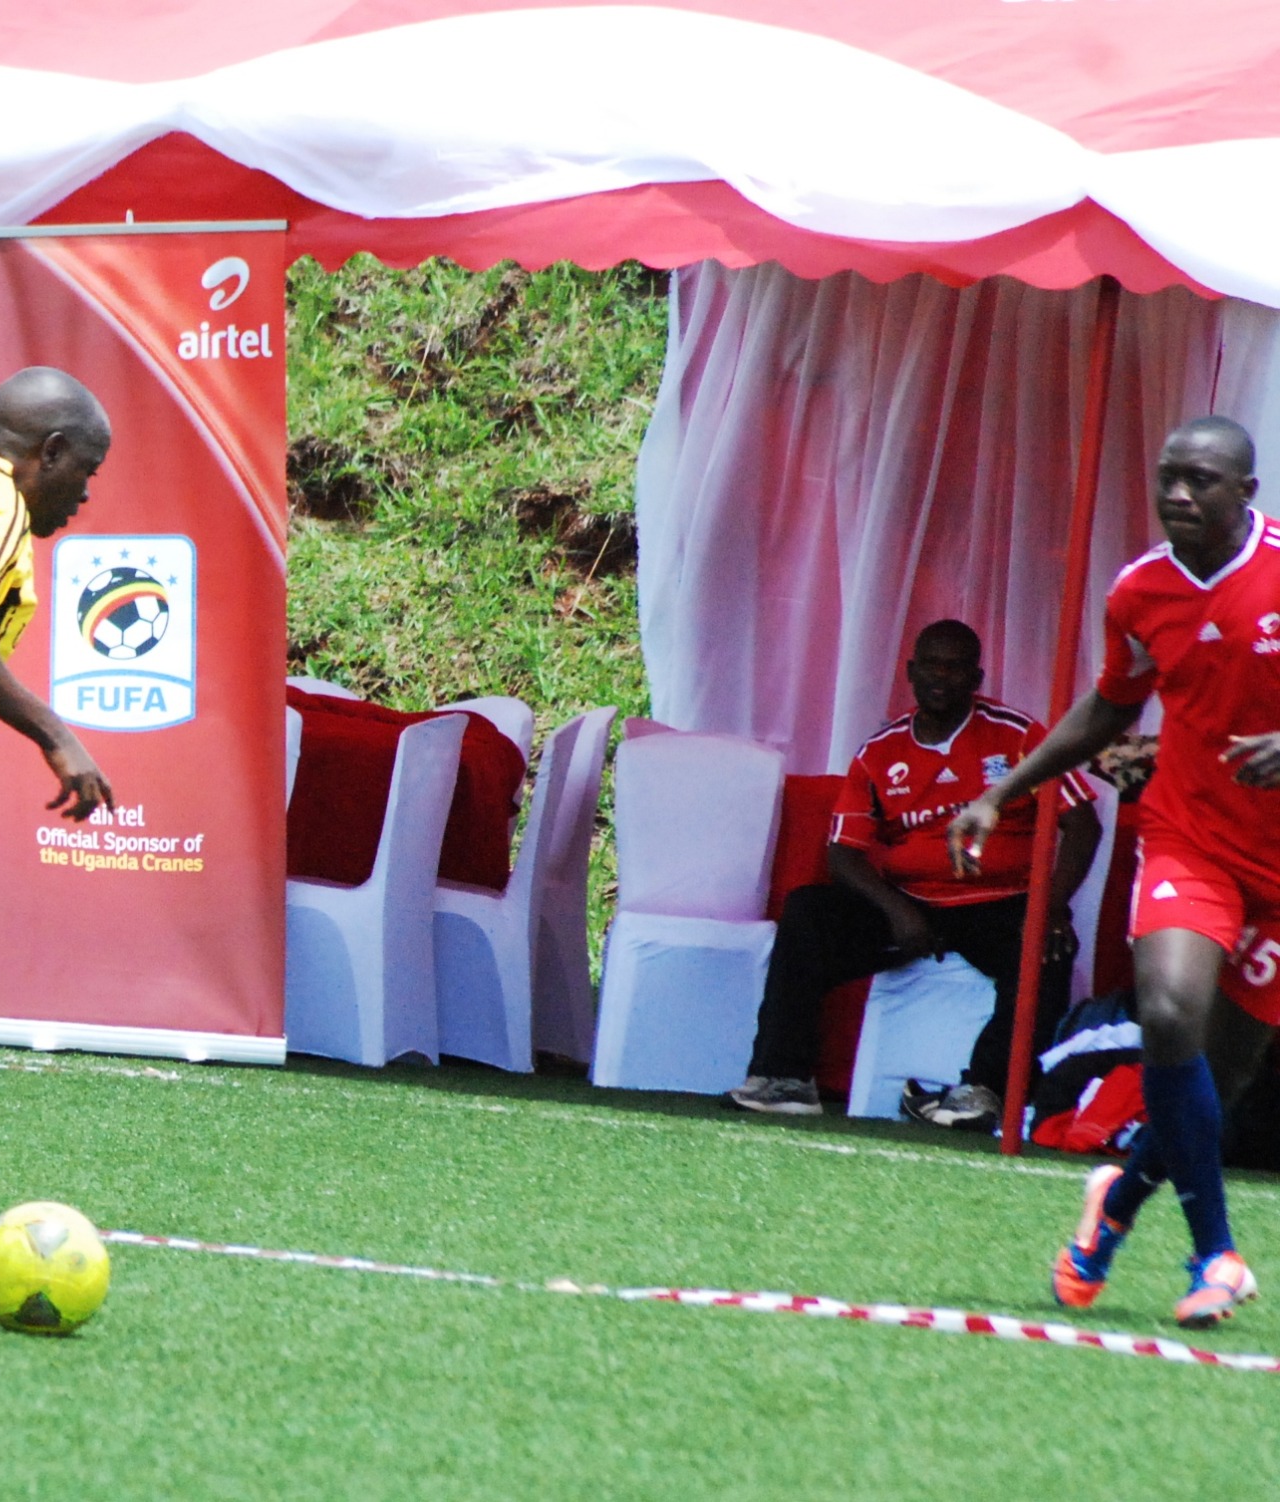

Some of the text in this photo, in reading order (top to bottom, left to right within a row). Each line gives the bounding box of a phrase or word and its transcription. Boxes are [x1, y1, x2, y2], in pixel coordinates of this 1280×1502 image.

[177, 322, 273, 360] airtel
[77, 685, 167, 712] FUFA
[36, 826, 205, 855] Official Sponsor of
[39, 847, 204, 872] the Uganda Cranes
